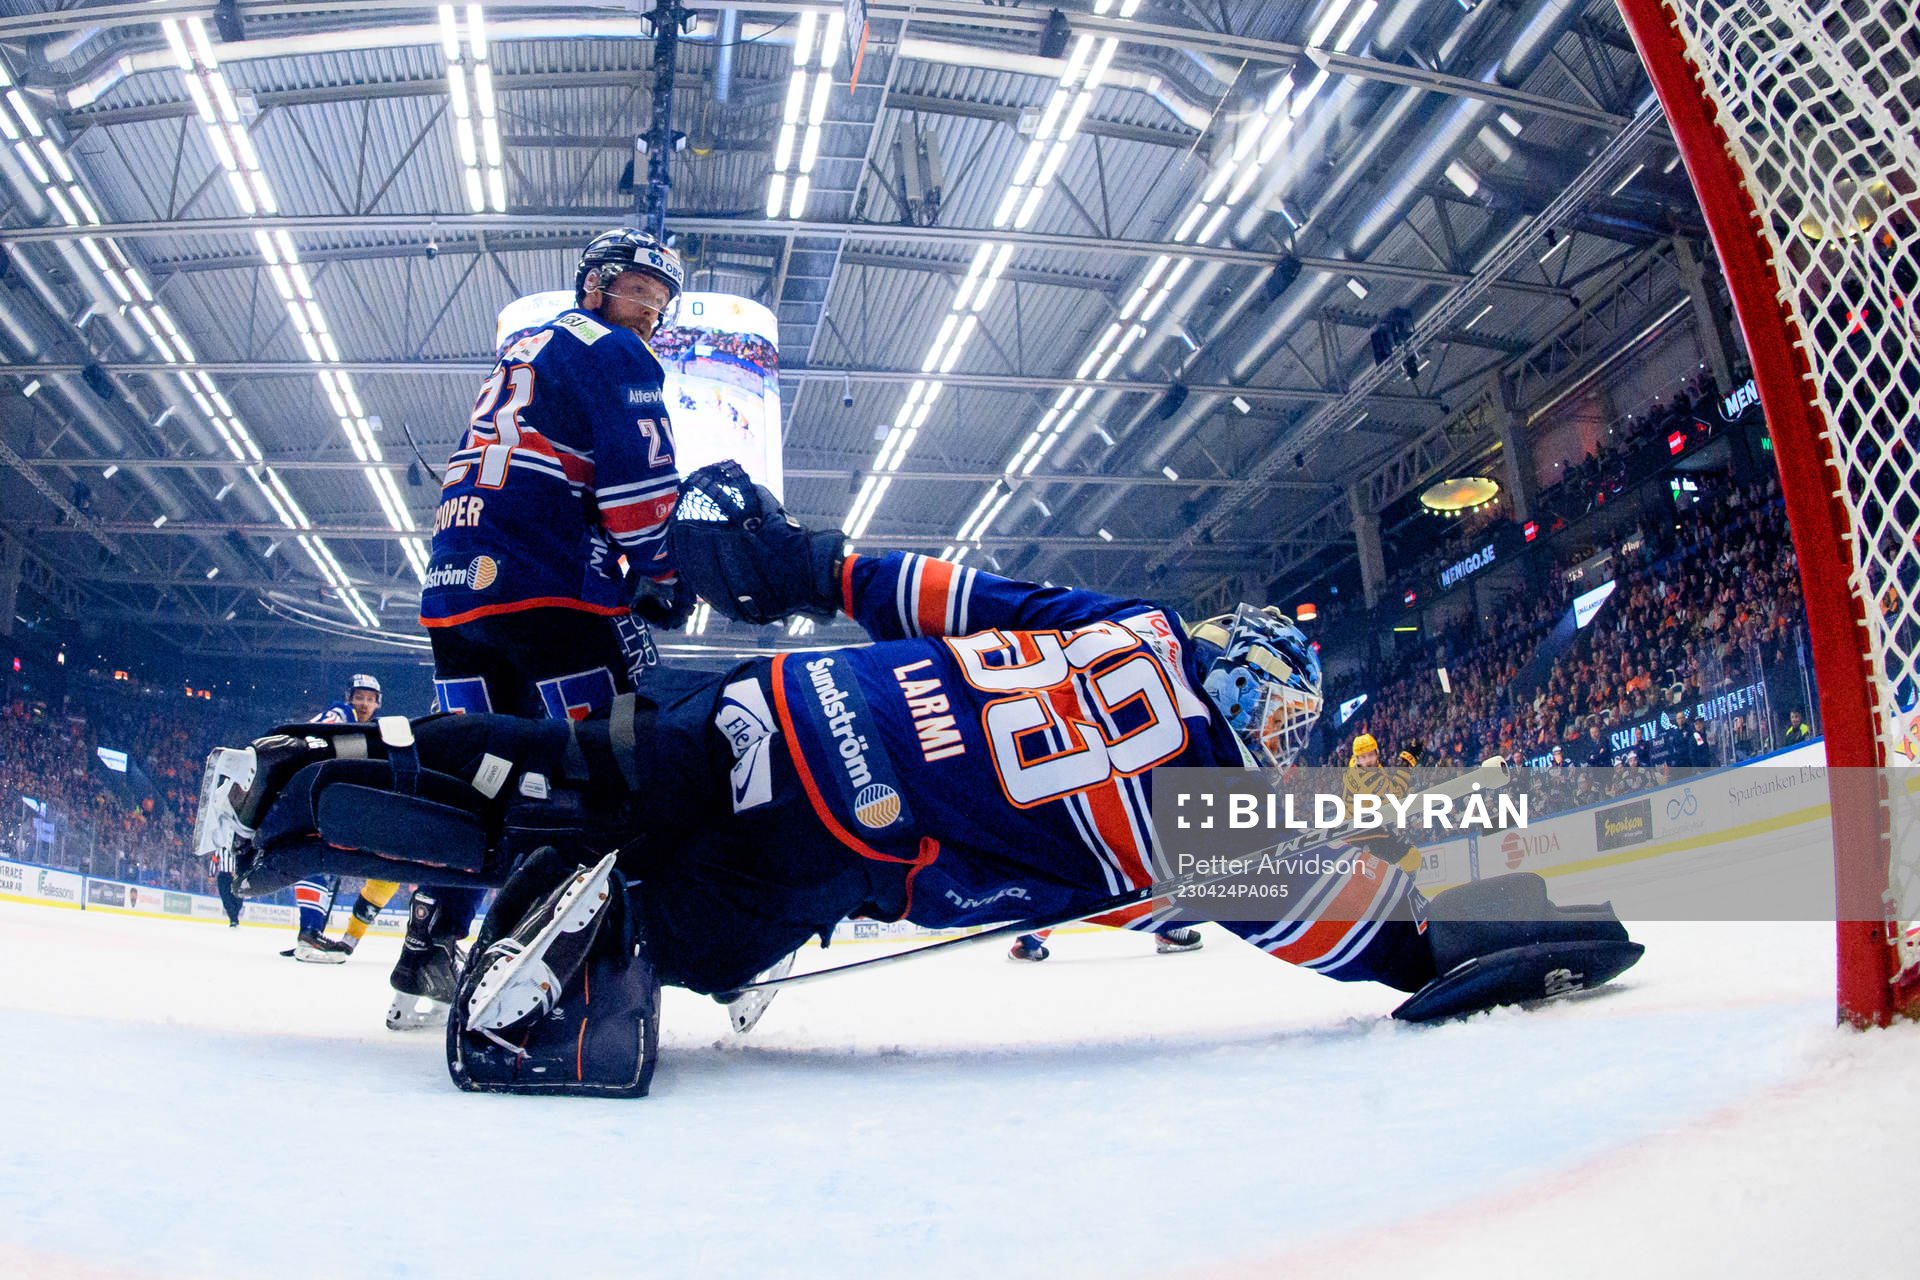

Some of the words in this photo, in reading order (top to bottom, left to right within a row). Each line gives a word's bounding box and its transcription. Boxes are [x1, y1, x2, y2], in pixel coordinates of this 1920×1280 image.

[805, 657, 873, 789] Sundström
[893, 659, 966, 762] LARMI
[1728, 775, 1796, 806] Sparbanken
[1522, 832, 1561, 857] VIDA
